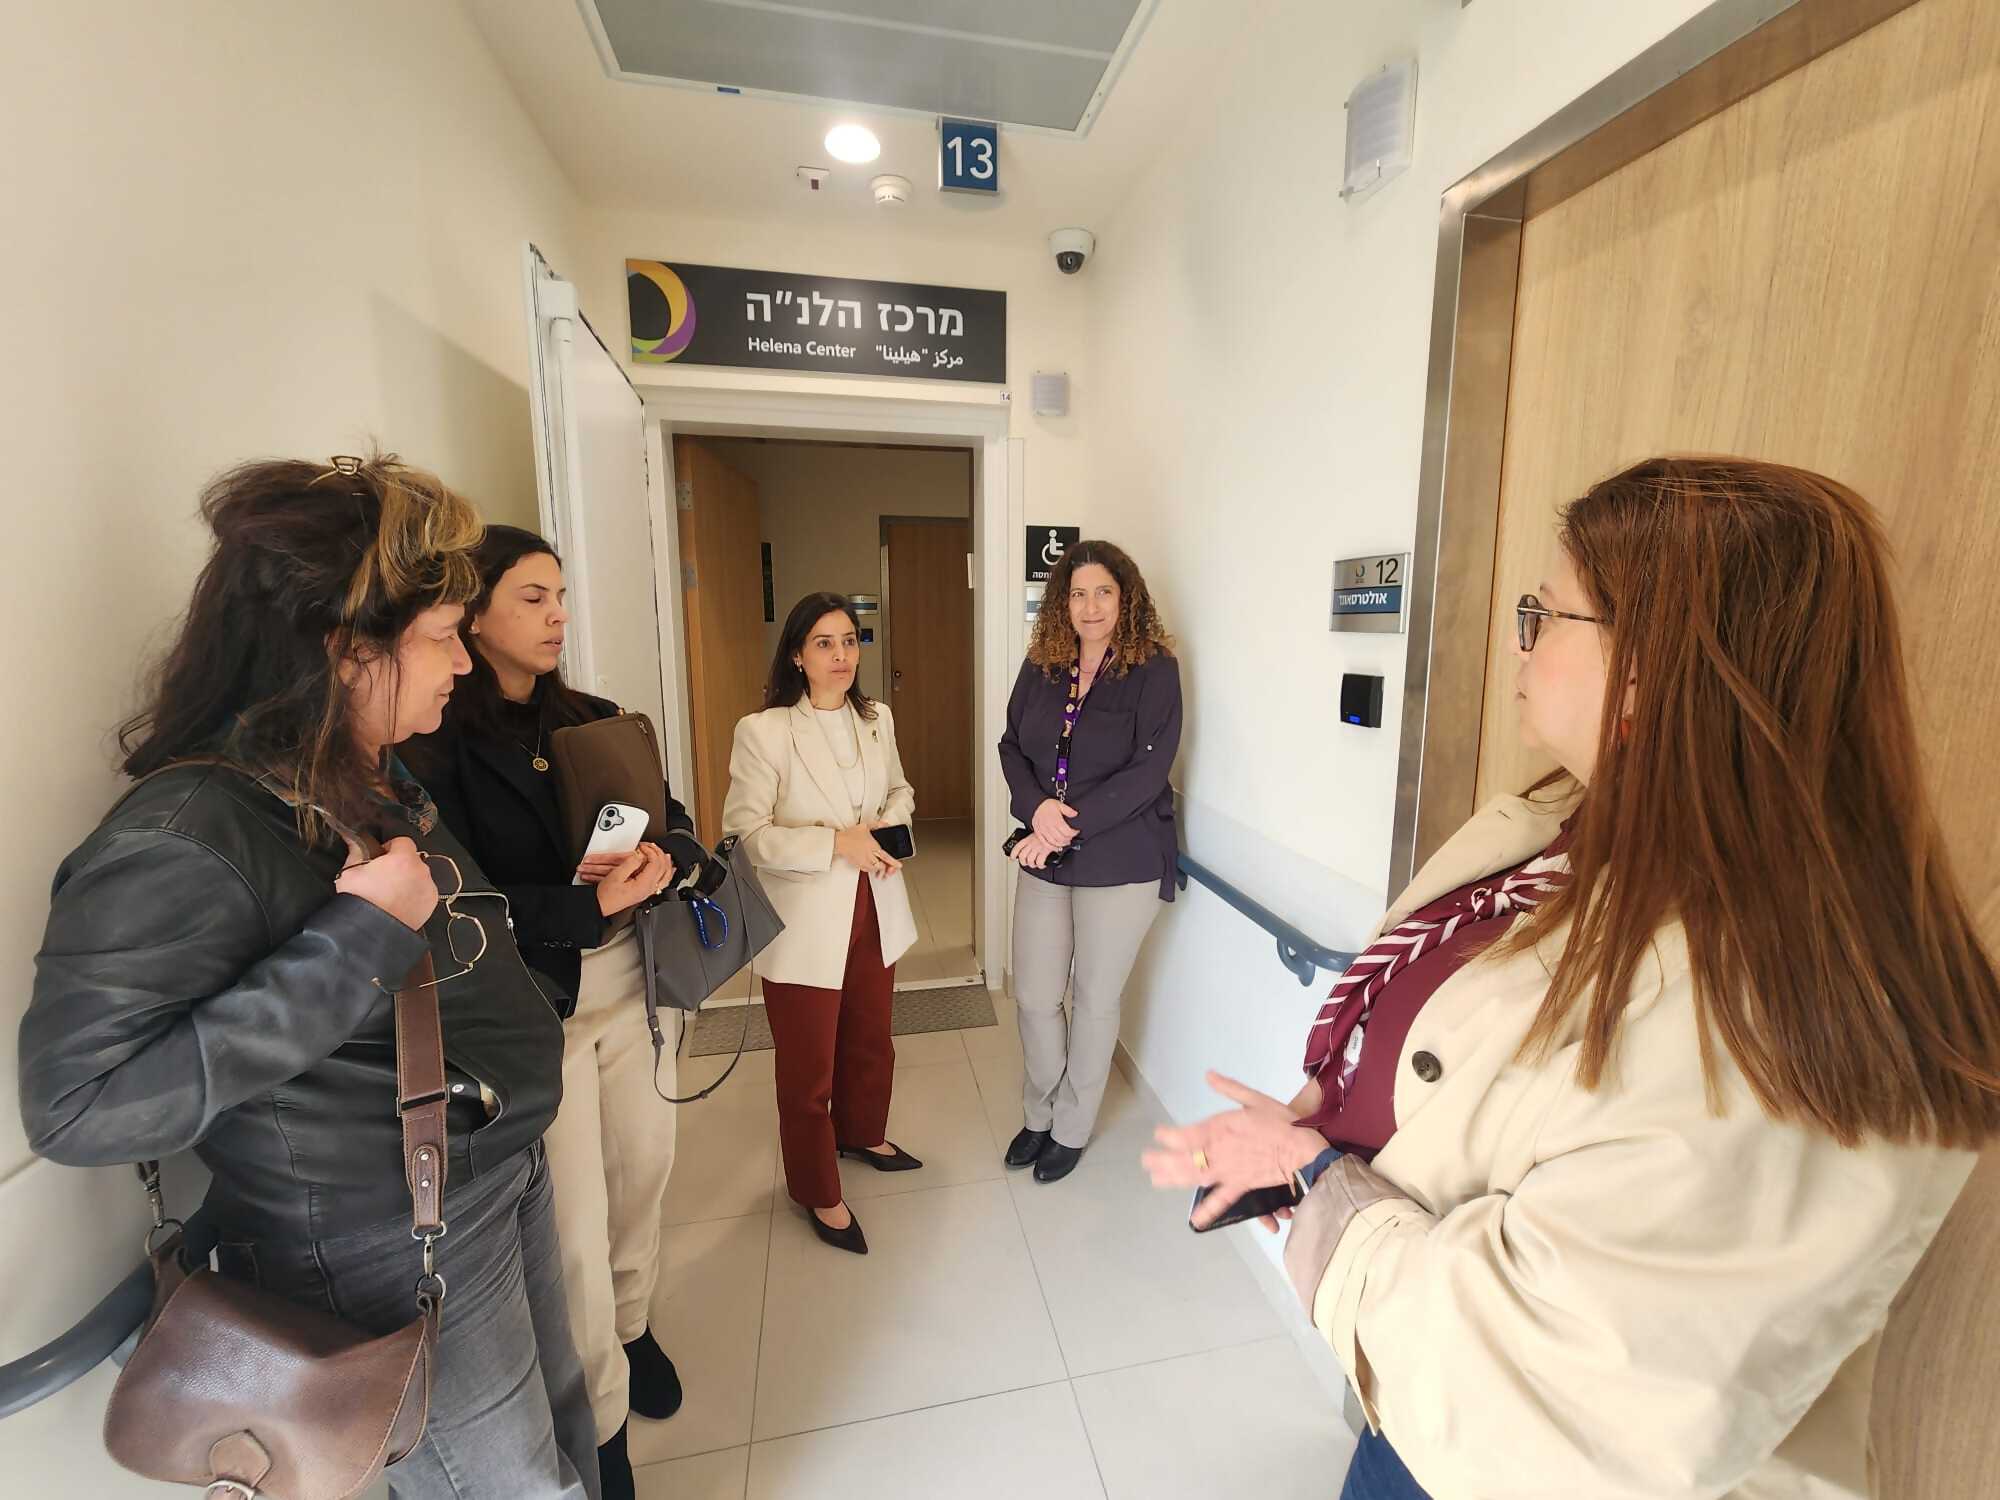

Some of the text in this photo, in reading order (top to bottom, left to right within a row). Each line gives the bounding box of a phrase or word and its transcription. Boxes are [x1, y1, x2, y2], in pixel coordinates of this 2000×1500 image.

[946, 136, 994, 180] 13
[746, 290, 965, 337] מרכז הלנ״ה
[748, 337, 857, 358] Helena Center
[876, 345, 964, 369] مركز "هيلينا"
[1376, 557, 1399, 585] 12
[1339, 591, 1388, 606] אולטרסאונד
